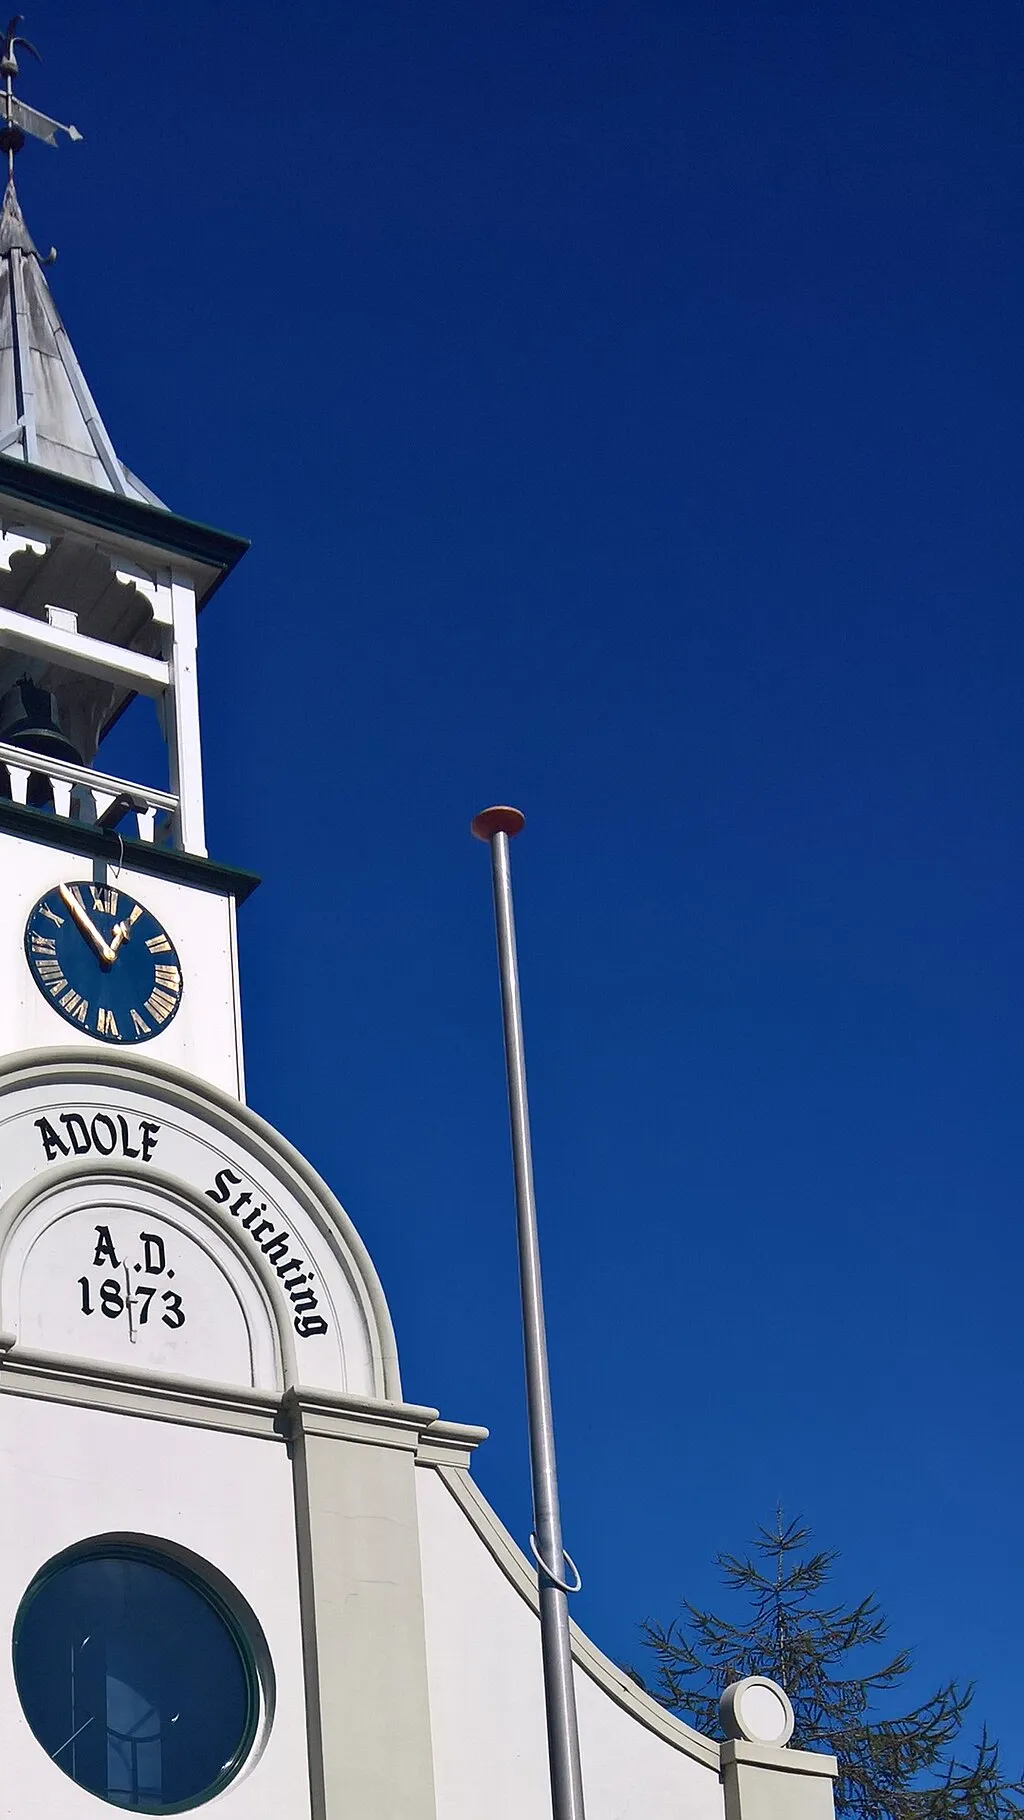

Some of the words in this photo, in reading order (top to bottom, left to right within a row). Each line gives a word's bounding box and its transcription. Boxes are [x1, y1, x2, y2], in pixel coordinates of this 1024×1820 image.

[33, 1112, 161, 1163] ADOLF
[205, 1168, 330, 1339] Stichting
[77, 1276, 187, 1329] 1873
